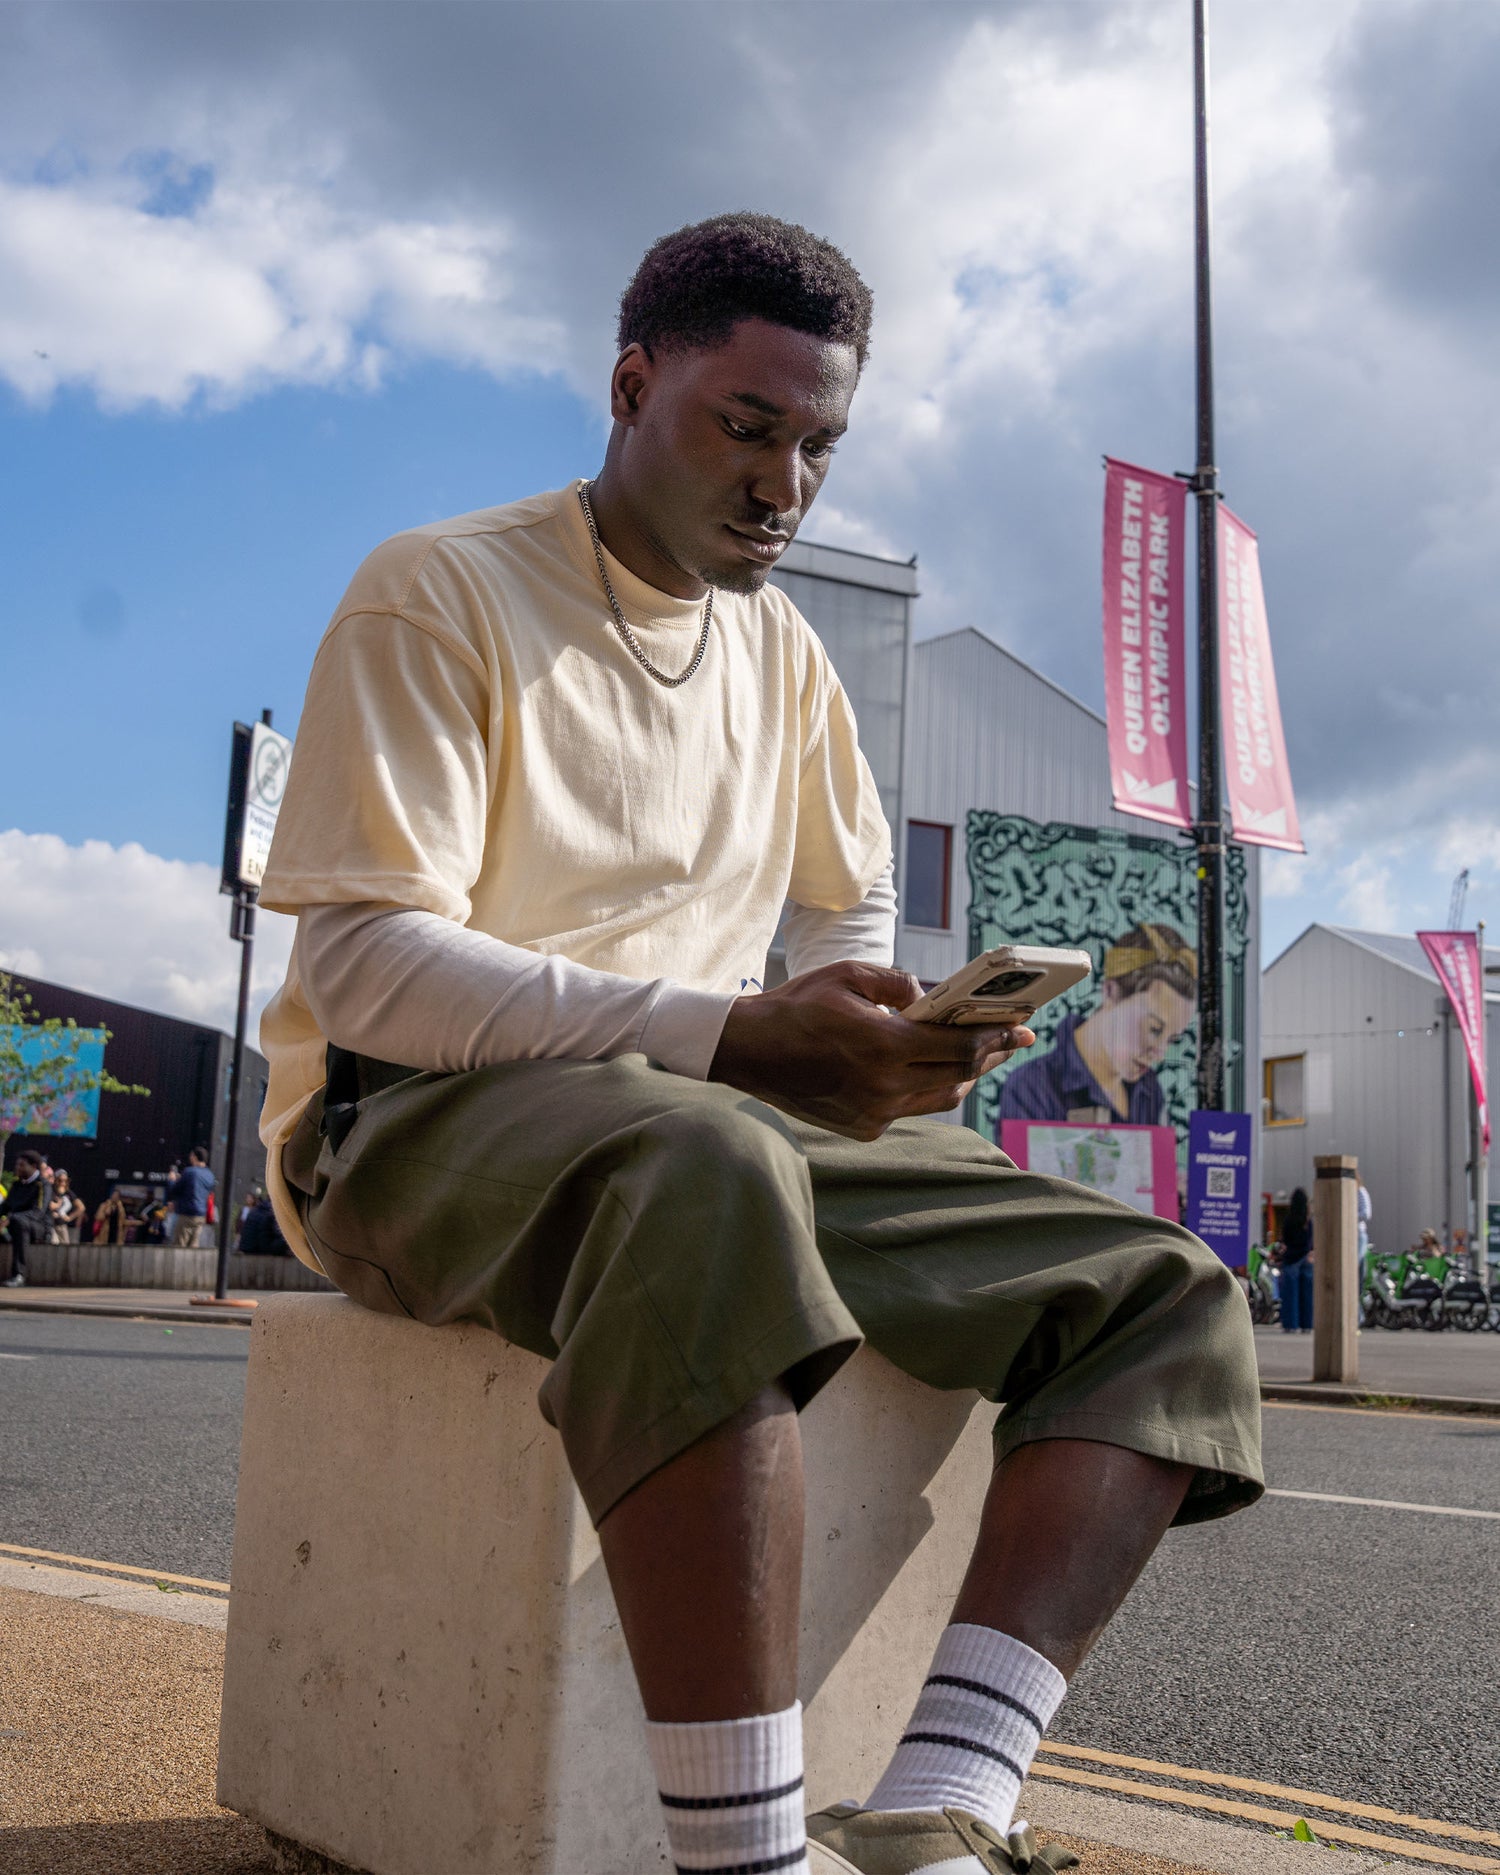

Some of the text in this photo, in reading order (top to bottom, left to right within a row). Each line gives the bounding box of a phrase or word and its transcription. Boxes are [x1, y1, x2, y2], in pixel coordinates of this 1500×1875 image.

[1121, 479, 1148, 755] QUEEN ELIZABETH
[1148, 511, 1171, 736] OLYMPIC PARK
[1225, 525, 1257, 785] QUEEN ELIZABETH
[1244, 641, 1273, 768] OLYMPIC
[1196, 1152, 1247, 1167] HUNGRY?
